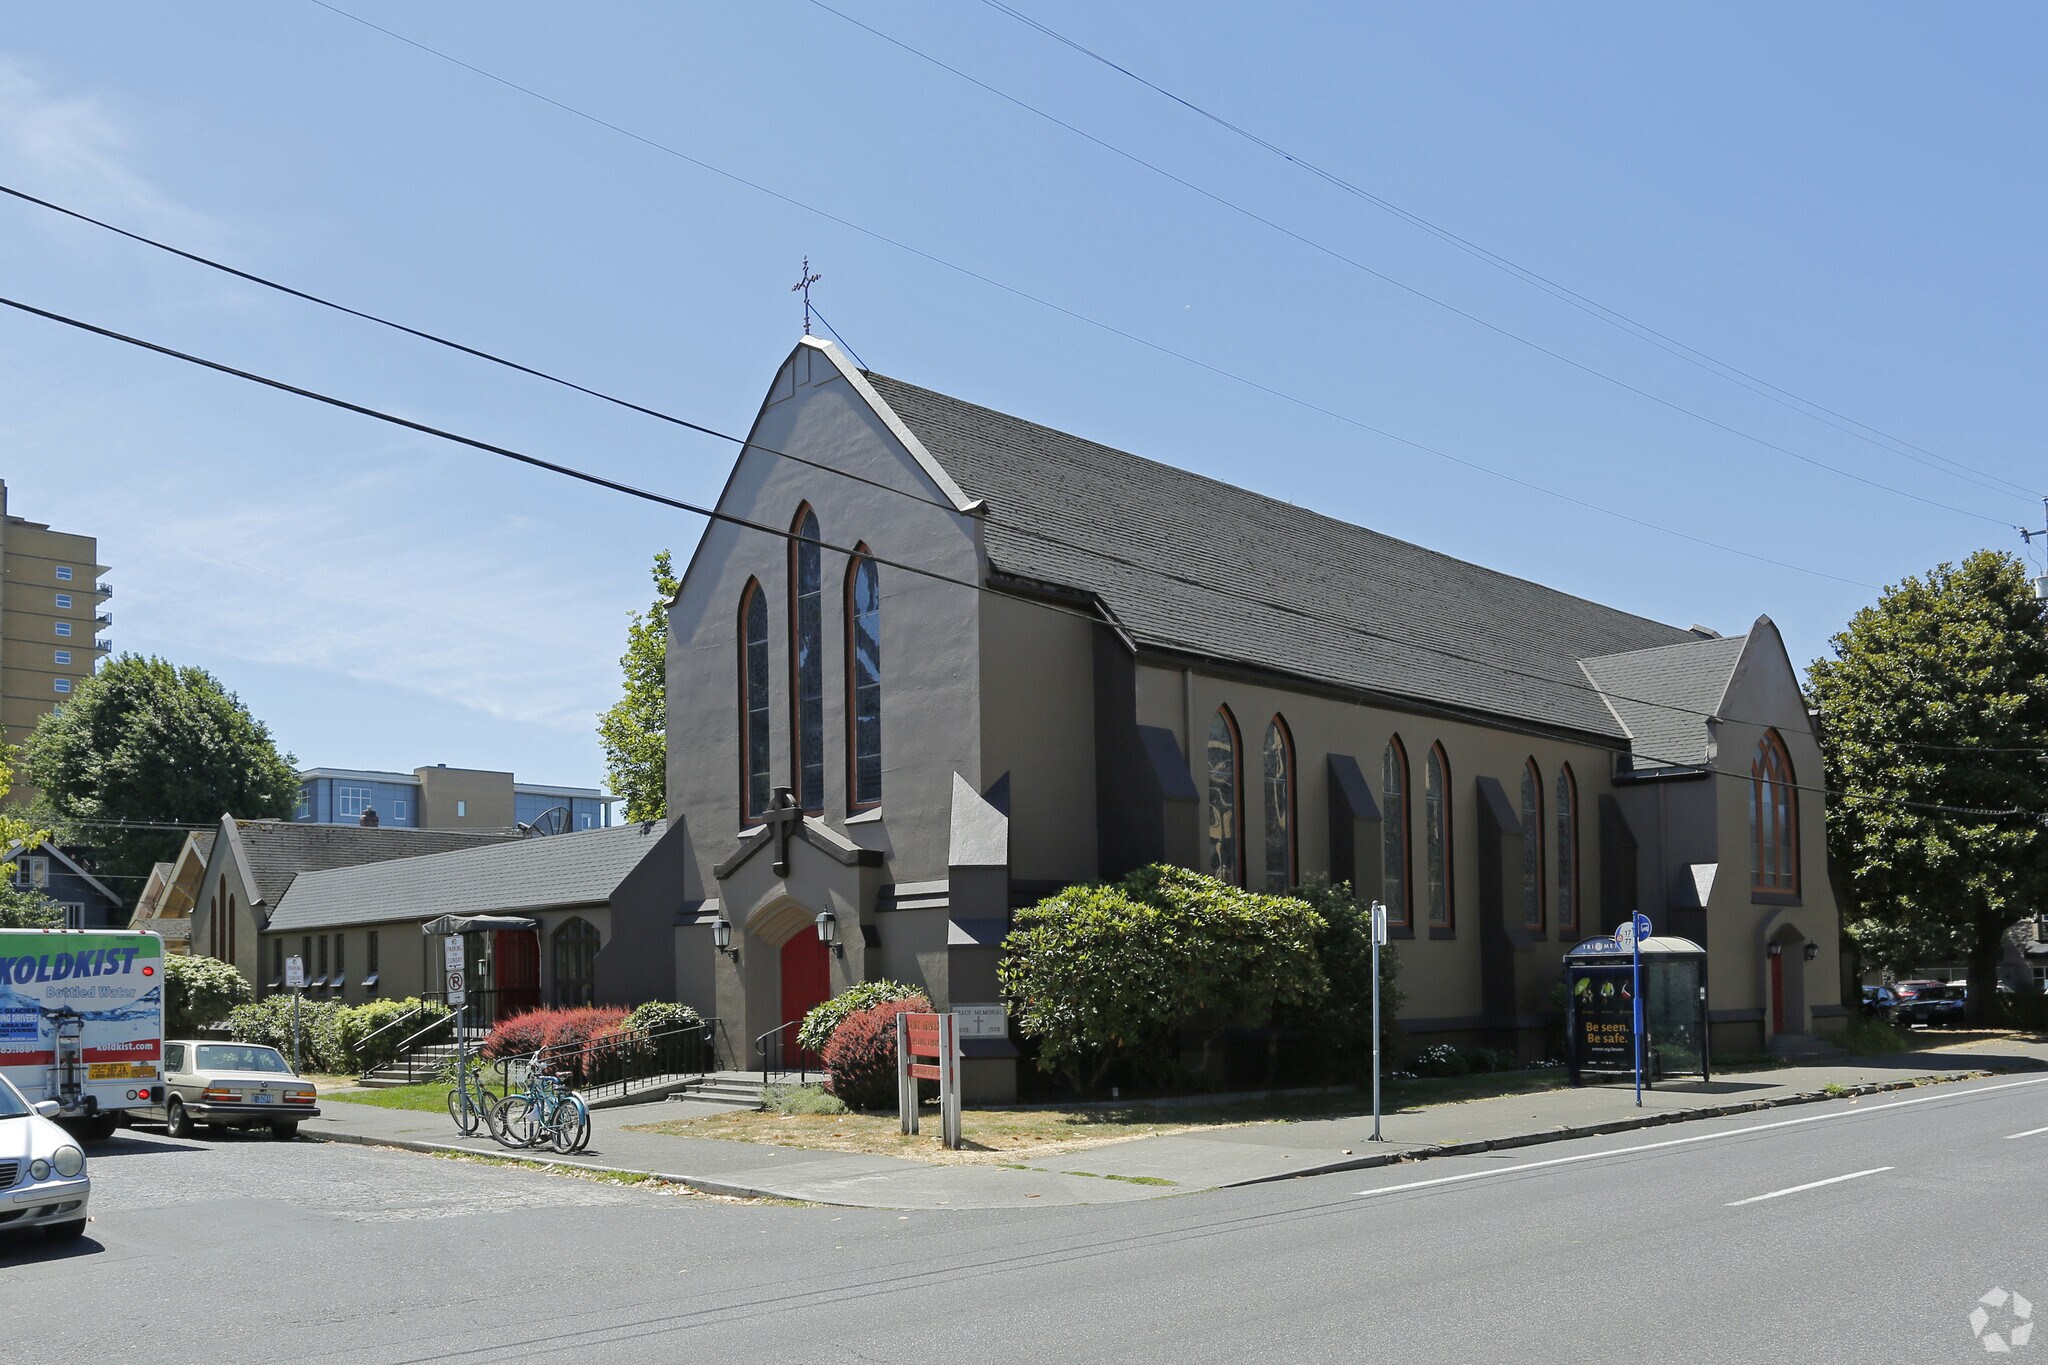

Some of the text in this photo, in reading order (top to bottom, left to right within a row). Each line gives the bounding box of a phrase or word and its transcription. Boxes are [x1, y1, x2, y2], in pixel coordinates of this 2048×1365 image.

[0, 947, 140, 986] KOLDKIST
[46, 986, 137, 999] Bottled Water
[12, 1014, 37, 1022] DRIVERS
[1586, 1022, 1629, 1032] Be seen.
[1587, 1033, 1628, 1043] Be safe.
[96, 1042, 153, 1051] koldkist.com
